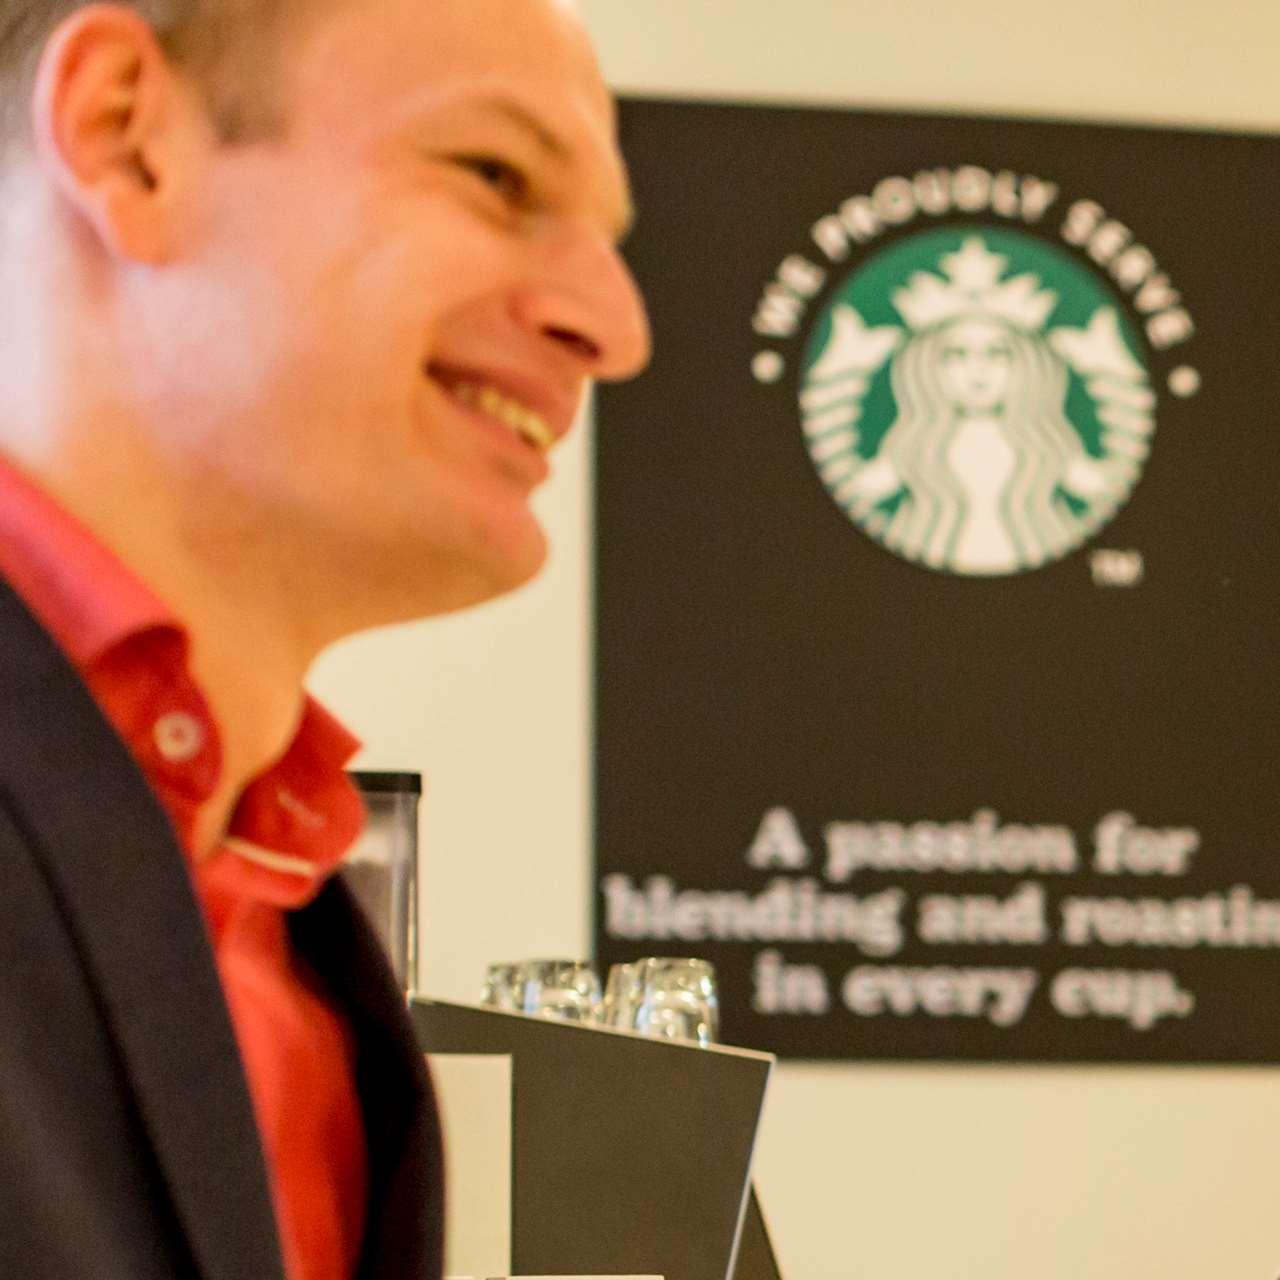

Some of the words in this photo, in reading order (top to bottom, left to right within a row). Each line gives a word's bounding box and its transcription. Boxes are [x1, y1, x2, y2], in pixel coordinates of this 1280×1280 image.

[753, 254, 826, 339] WE
[811, 165, 1058, 261] PROUDLY
[1062, 200, 1194, 349] SERVE
[747, 806, 810, 870] A
[823, 809, 1078, 884] passion
[1093, 810, 1202, 876] for
[603, 872, 902, 956] blending
[918, 880, 1046, 944] and
[753, 948, 829, 1014] in
[841, 964, 1037, 1027] every
[1050, 967, 1195, 1030] cup.
